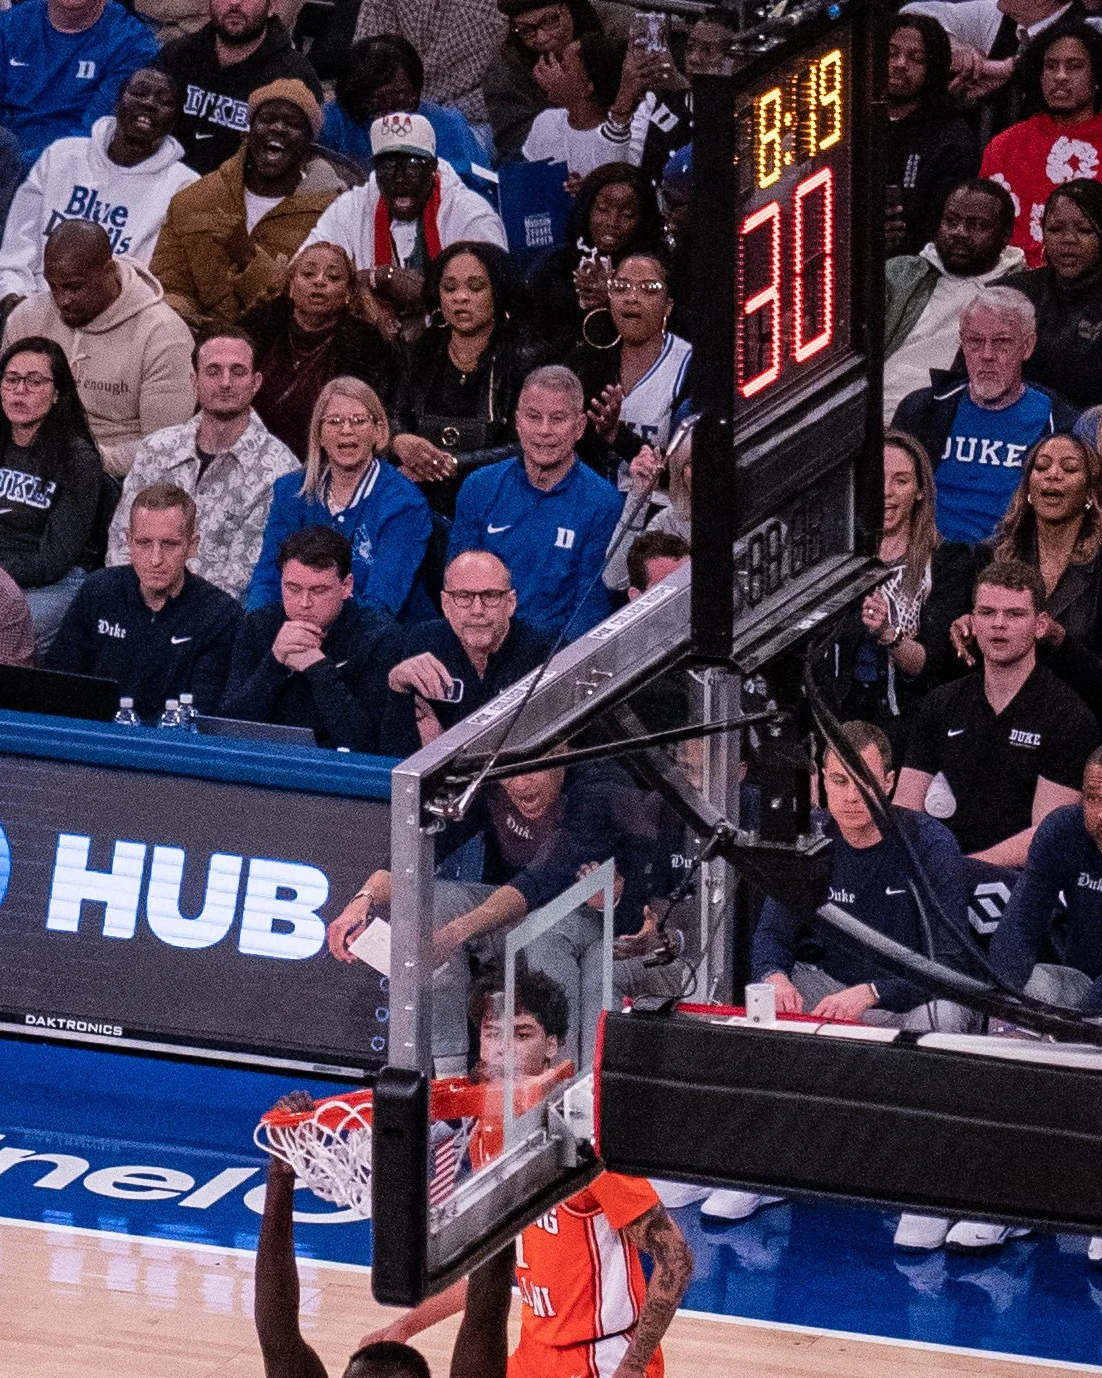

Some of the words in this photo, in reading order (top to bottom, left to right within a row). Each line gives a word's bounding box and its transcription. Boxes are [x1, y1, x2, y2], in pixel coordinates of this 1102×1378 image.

[757, 49, 842, 190] 8:19
[64, 185, 129, 229] Blue
[739, 165, 835, 399] 30
[1009, 729, 1042, 746] DUKE
[46, 832, 330, 961] HUB
[25, 1013, 123, 1036] DAKTRONICS
